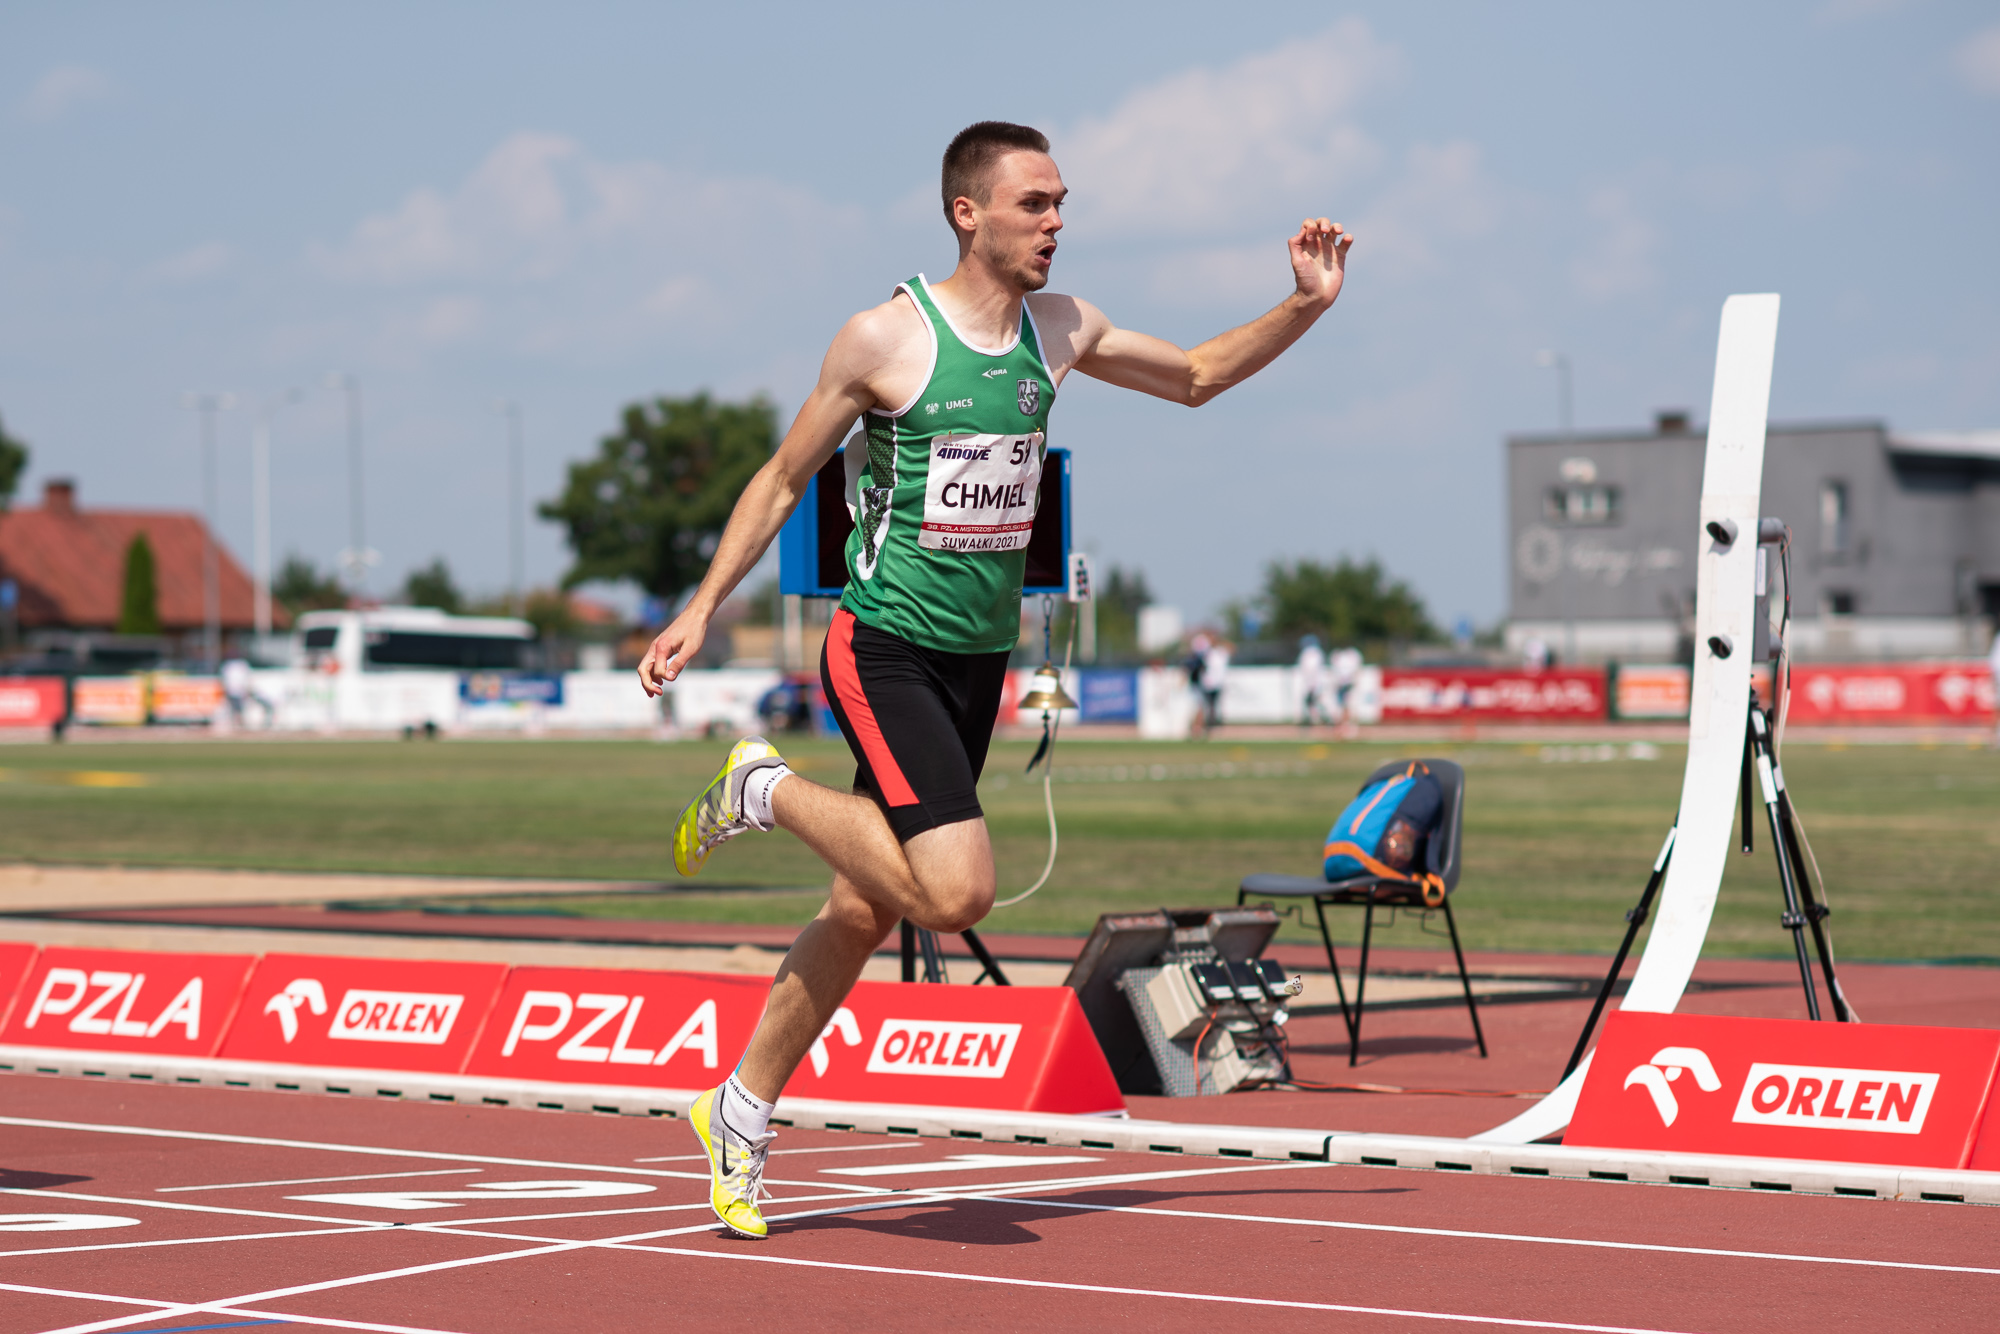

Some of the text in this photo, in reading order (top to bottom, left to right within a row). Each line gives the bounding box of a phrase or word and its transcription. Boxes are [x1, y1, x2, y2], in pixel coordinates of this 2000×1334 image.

[945, 398, 974, 410] UMCS
[941, 482, 1027, 510] CHMIEL
[940, 535, 1018, 549] SUWAŁKI 2021
[1002, 524, 1020, 532] POLSKI
[25, 967, 203, 1040] PZLA
[343, 999, 453, 1034] ORLEN
[500, 990, 718, 1069] PZLA
[881, 1028, 1009, 1069] ORLEN
[729, 1078, 759, 1110] adidas
[1751, 1074, 1922, 1123] ORLEN
